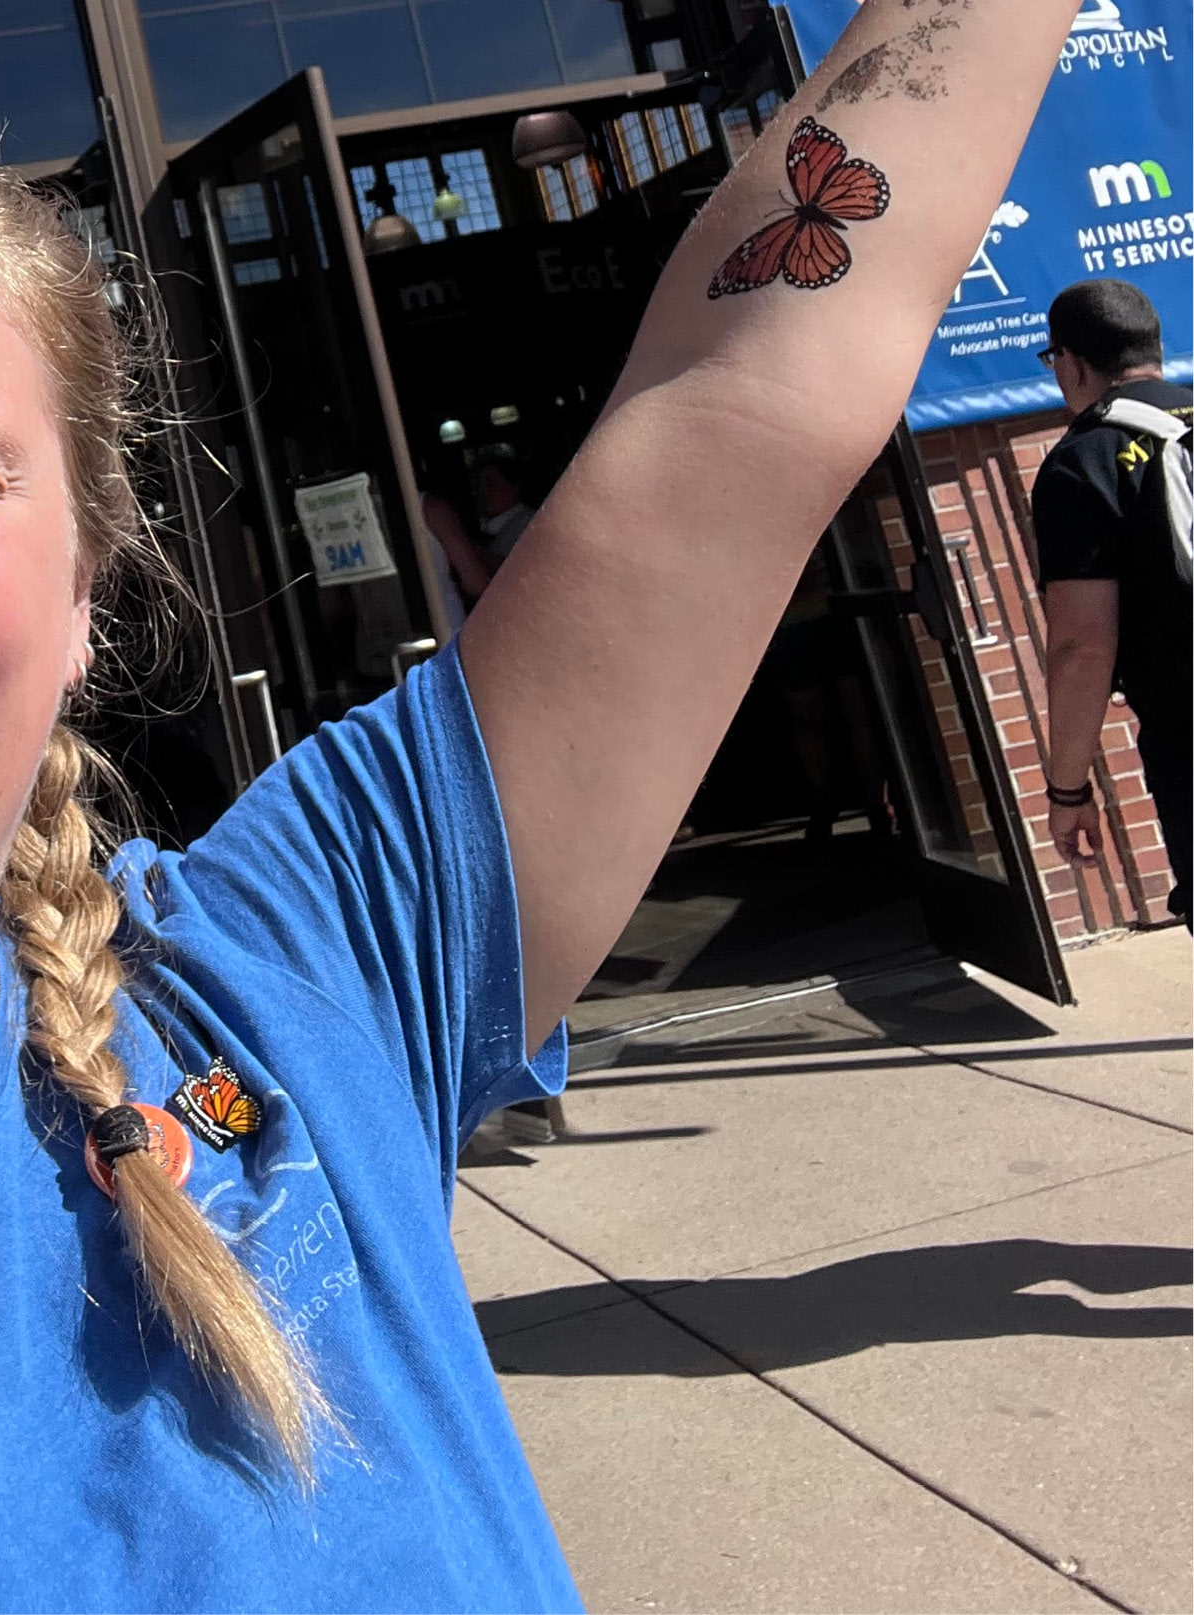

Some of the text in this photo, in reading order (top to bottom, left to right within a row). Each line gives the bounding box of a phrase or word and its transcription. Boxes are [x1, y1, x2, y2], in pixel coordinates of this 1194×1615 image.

[1059, 26, 1168, 59] OPOLITAN
[1059, 48, 1174, 74] UNCIL
[1089, 159, 1172, 207] mn
[1078, 212, 1193, 249] MINNESOT
[1085, 237, 1193, 272] IT SERVIC
[937, 312, 1047, 339] Minnesota Tree Care
[950, 331, 1048, 357] Advocate Program
